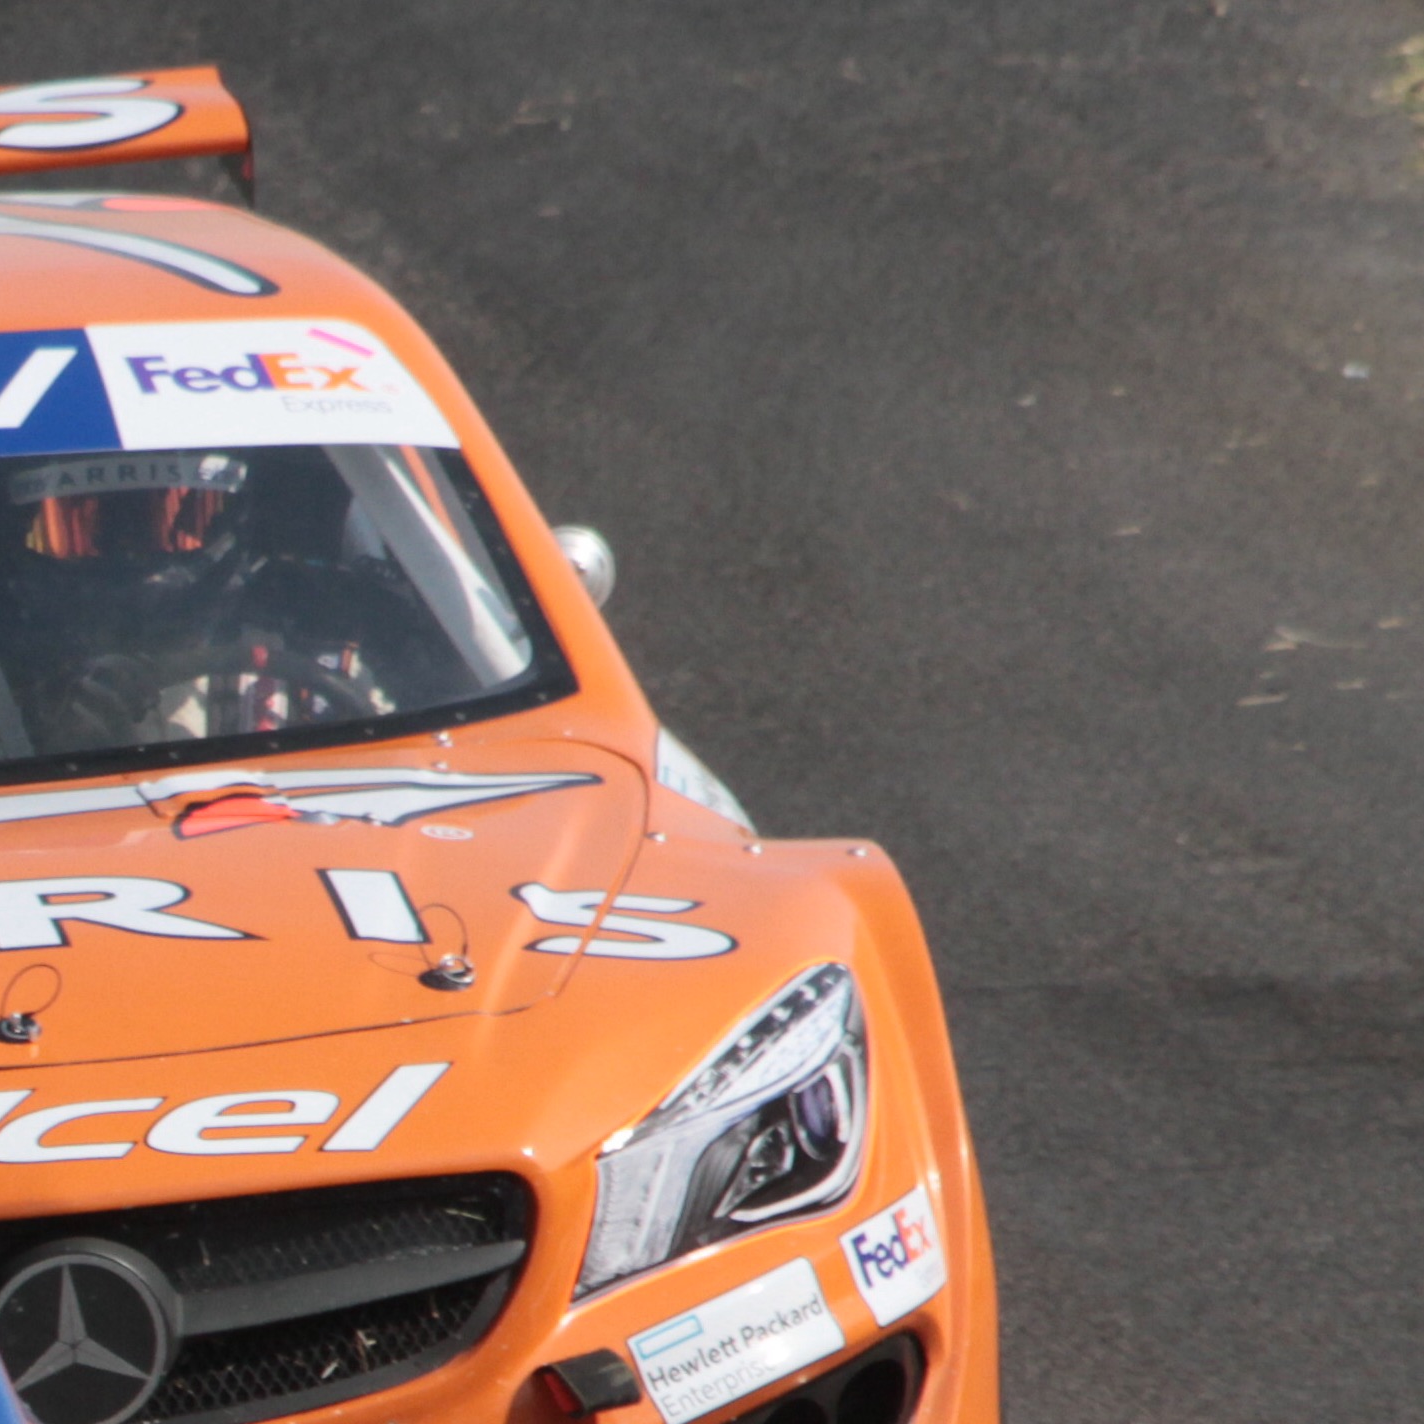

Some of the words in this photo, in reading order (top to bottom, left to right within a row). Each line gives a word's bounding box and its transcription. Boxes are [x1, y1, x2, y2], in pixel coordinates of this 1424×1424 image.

[123, 353, 370, 395] FedEx
[280, 395, 393, 415] Express
[851, 1207, 932, 1289] FedEx
[647, 1335, 739, 1393] Hewlett
[740, 1294, 824, 1347] Packard
